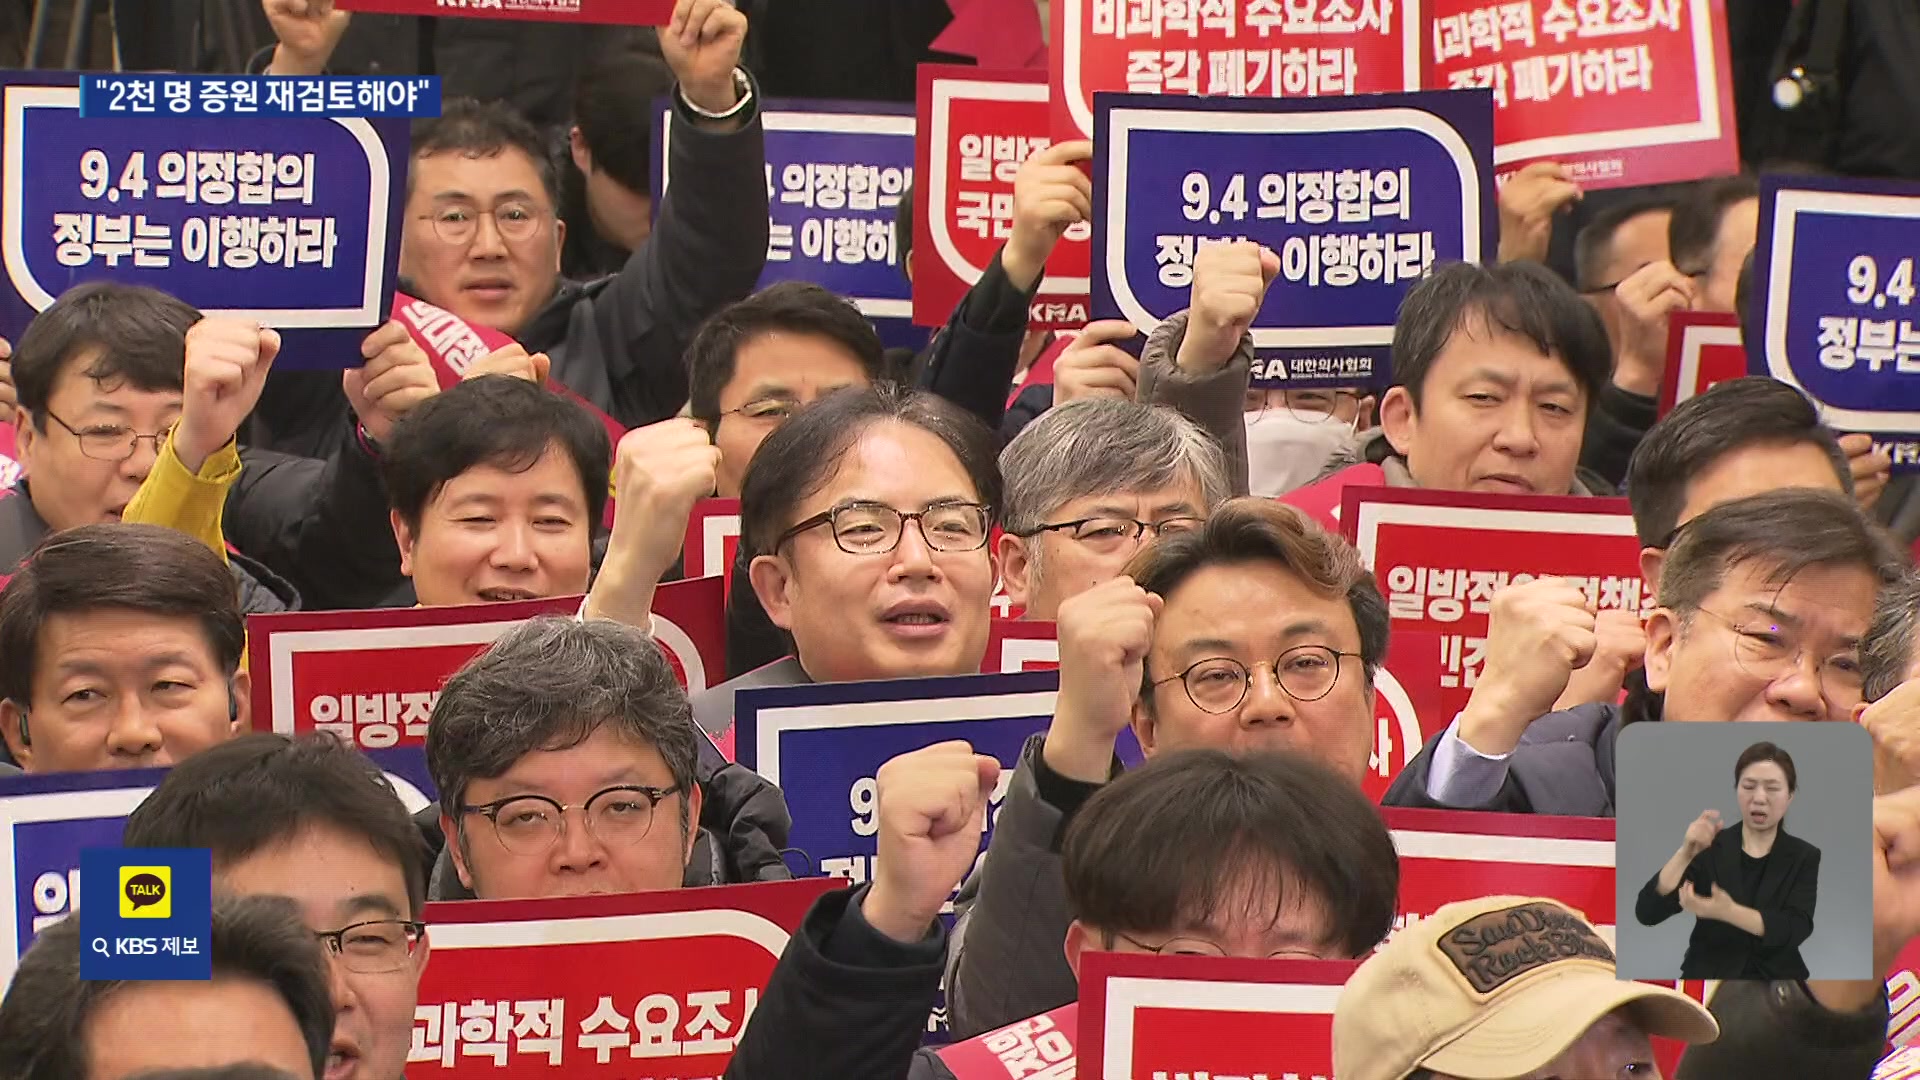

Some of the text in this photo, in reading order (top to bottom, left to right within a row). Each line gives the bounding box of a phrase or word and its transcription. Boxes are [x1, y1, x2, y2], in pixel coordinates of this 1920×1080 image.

[1092, 0, 1393, 39] 비과학적 수요조사
[1126, 48, 1357, 98] 즉각 폐기하라
[1512, 45, 1653, 102] 폐기하라
[79, 149, 315, 205] 9.4 의정합의
[959, 134, 1051, 182] 일방
[1182, 167, 1410, 225] 9.4 의정합의
[52, 212, 338, 269] 정부는 이행하라
[1281, 231, 1436, 287] 이행하라
[1847, 255, 1916, 309] 9.4
[1028, 303, 1088, 323] KMA
[406, 988, 760, 1068] 과학적 수요조
